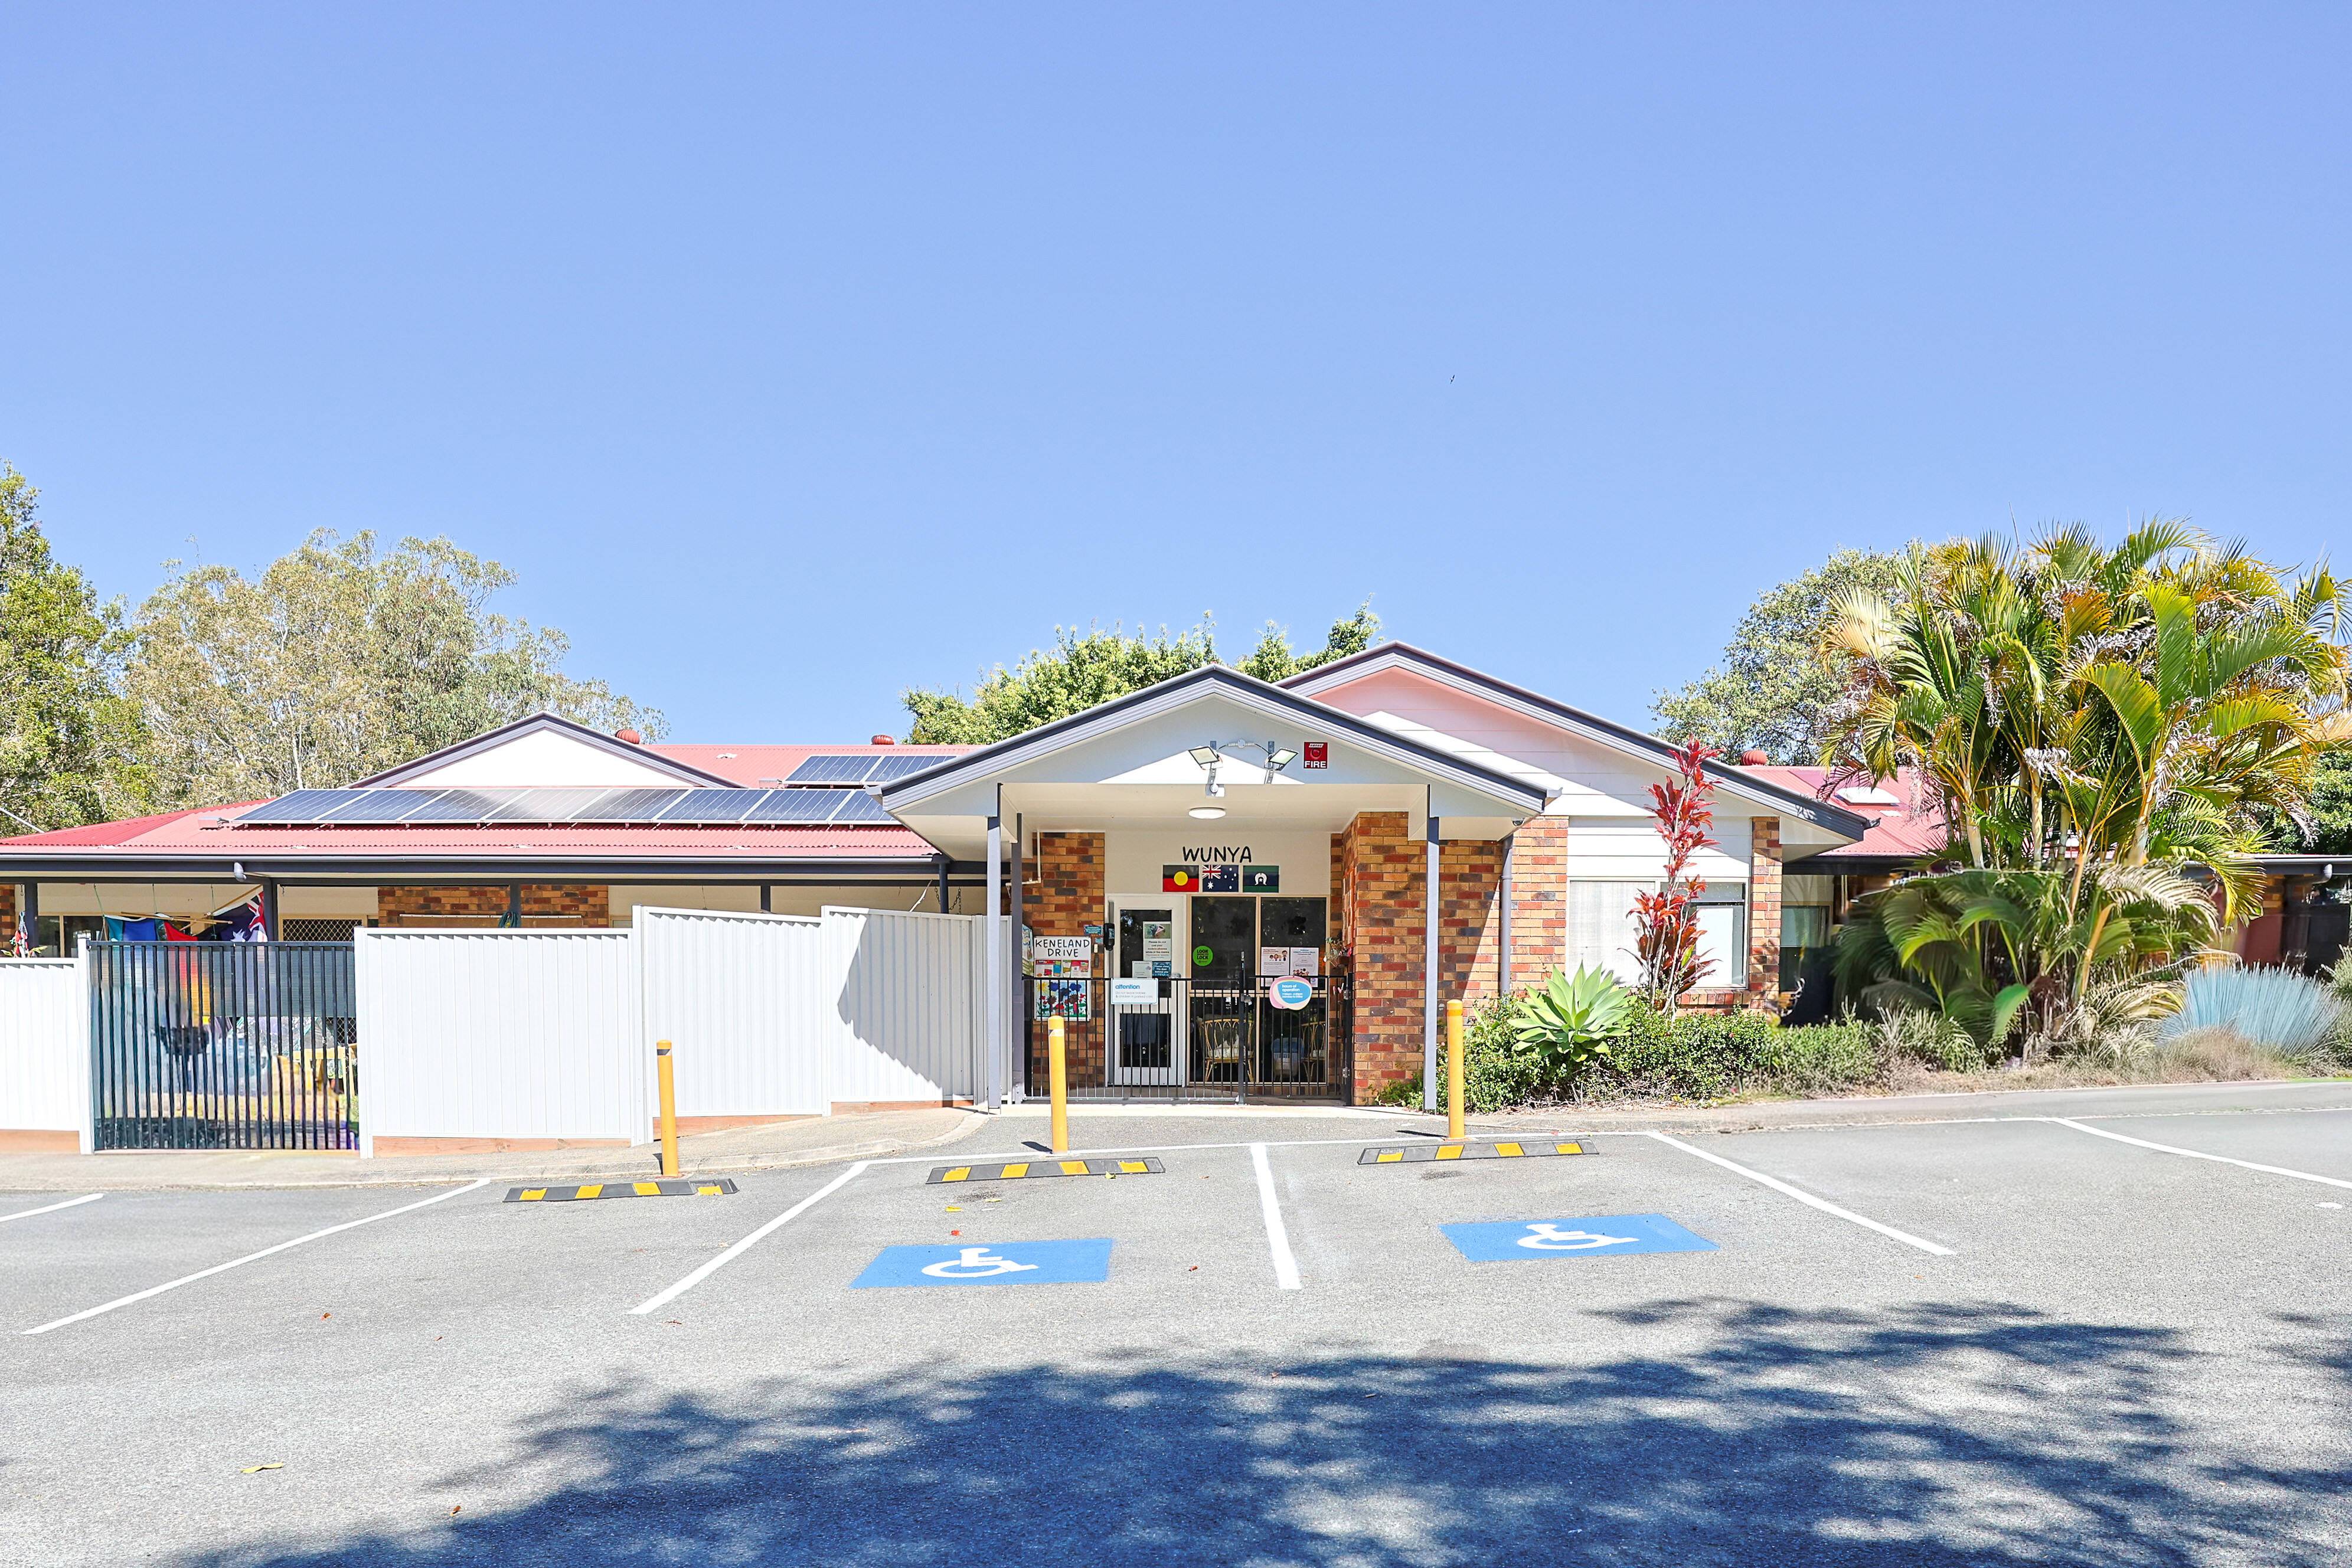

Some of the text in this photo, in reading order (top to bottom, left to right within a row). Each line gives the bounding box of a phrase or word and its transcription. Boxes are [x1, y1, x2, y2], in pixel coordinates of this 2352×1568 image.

[1182, 846, 1252, 863] WUNYA
[1035, 939, 1090, 948] KENELAND
[1047, 948, 1079, 957] DRIVE
